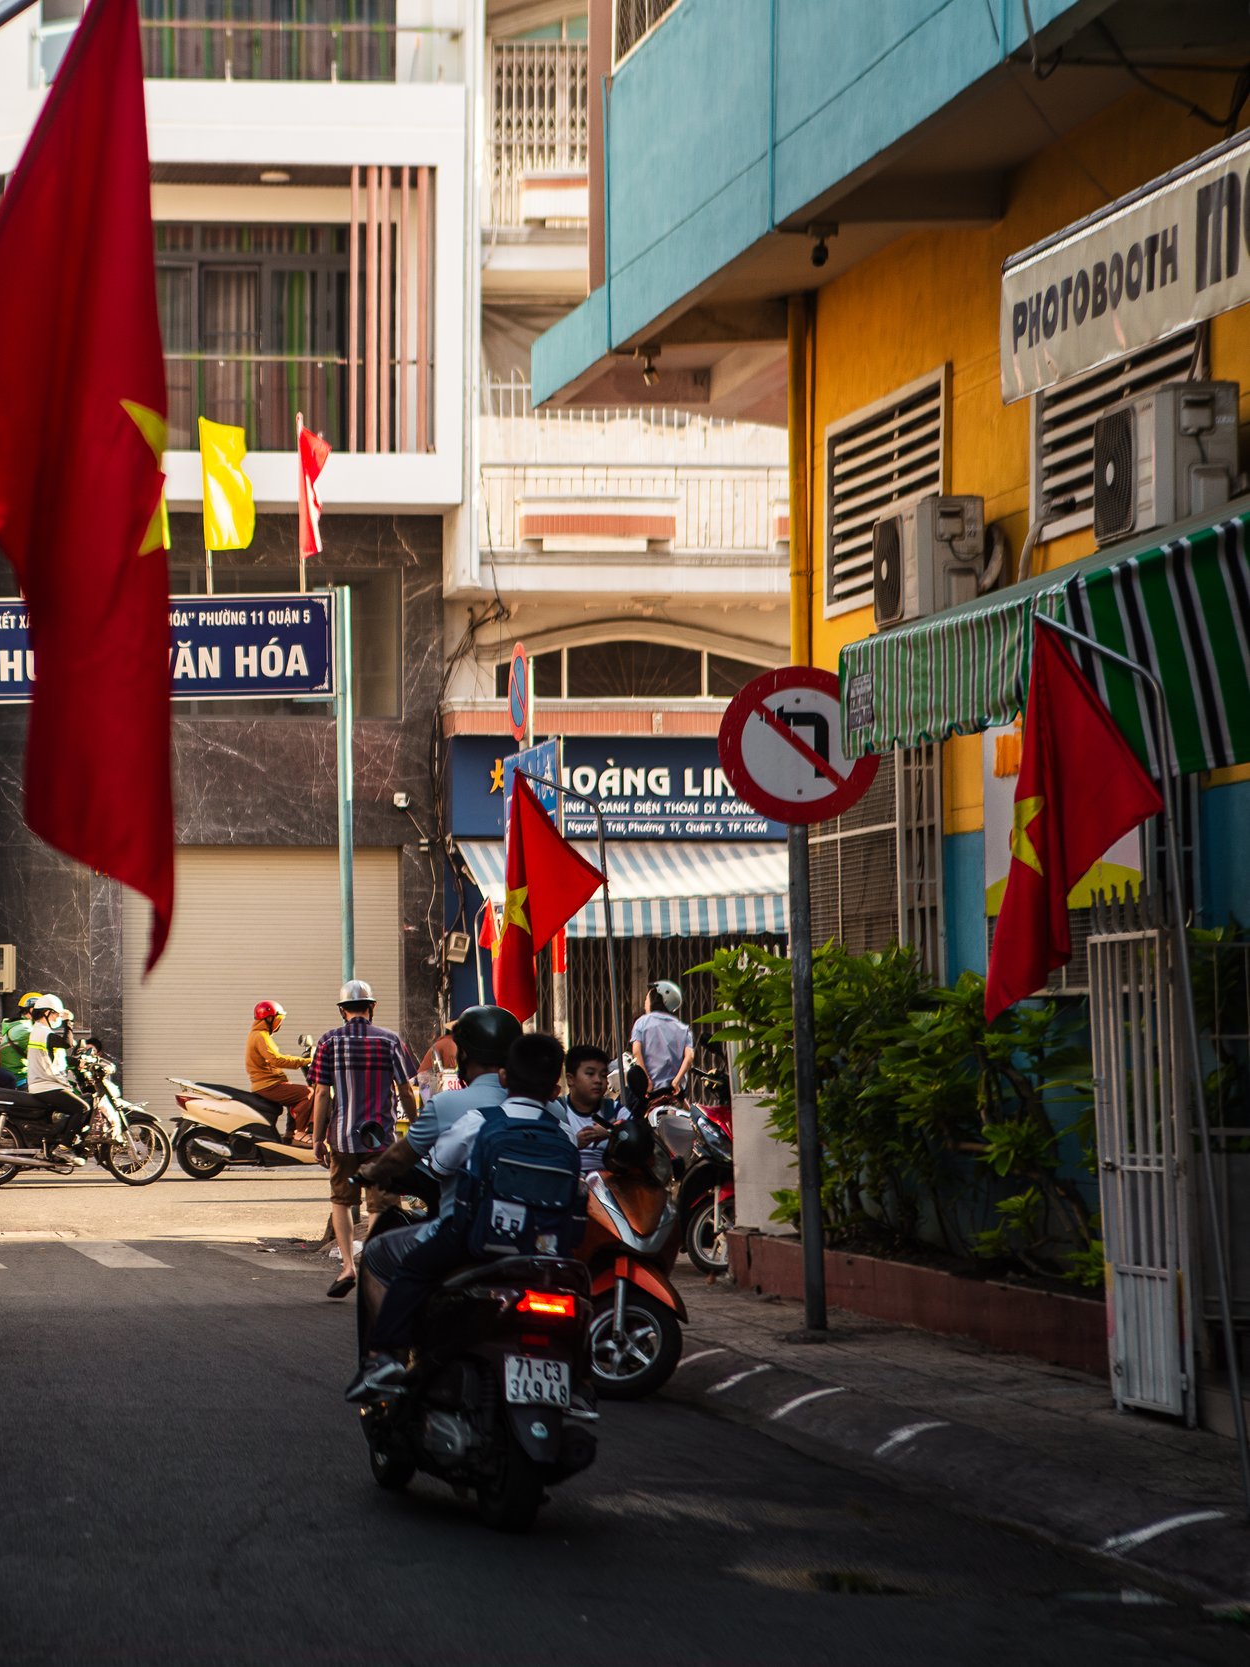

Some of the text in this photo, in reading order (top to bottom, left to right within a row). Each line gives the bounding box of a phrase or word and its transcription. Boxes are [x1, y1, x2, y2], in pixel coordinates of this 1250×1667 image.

[1013, 223, 1179, 354] PHOTOBOOTH
[199, 607, 247, 627] PHƯỜNG
[250, 610, 264, 626] 11
[267, 606, 300, 628] QUẬN
[303, 608, 311, 625] 5
[168, 639, 220, 680] ĂN
[234, 637, 310, 679] HÓA
[634, 799, 661, 817] ĐIỆN
[664, 800, 699, 816] THOẠI
[703, 801, 717, 815] DI
[727, 821, 768, 834] TP.HCM
[515, 1357, 562, 1382] 71-C3
